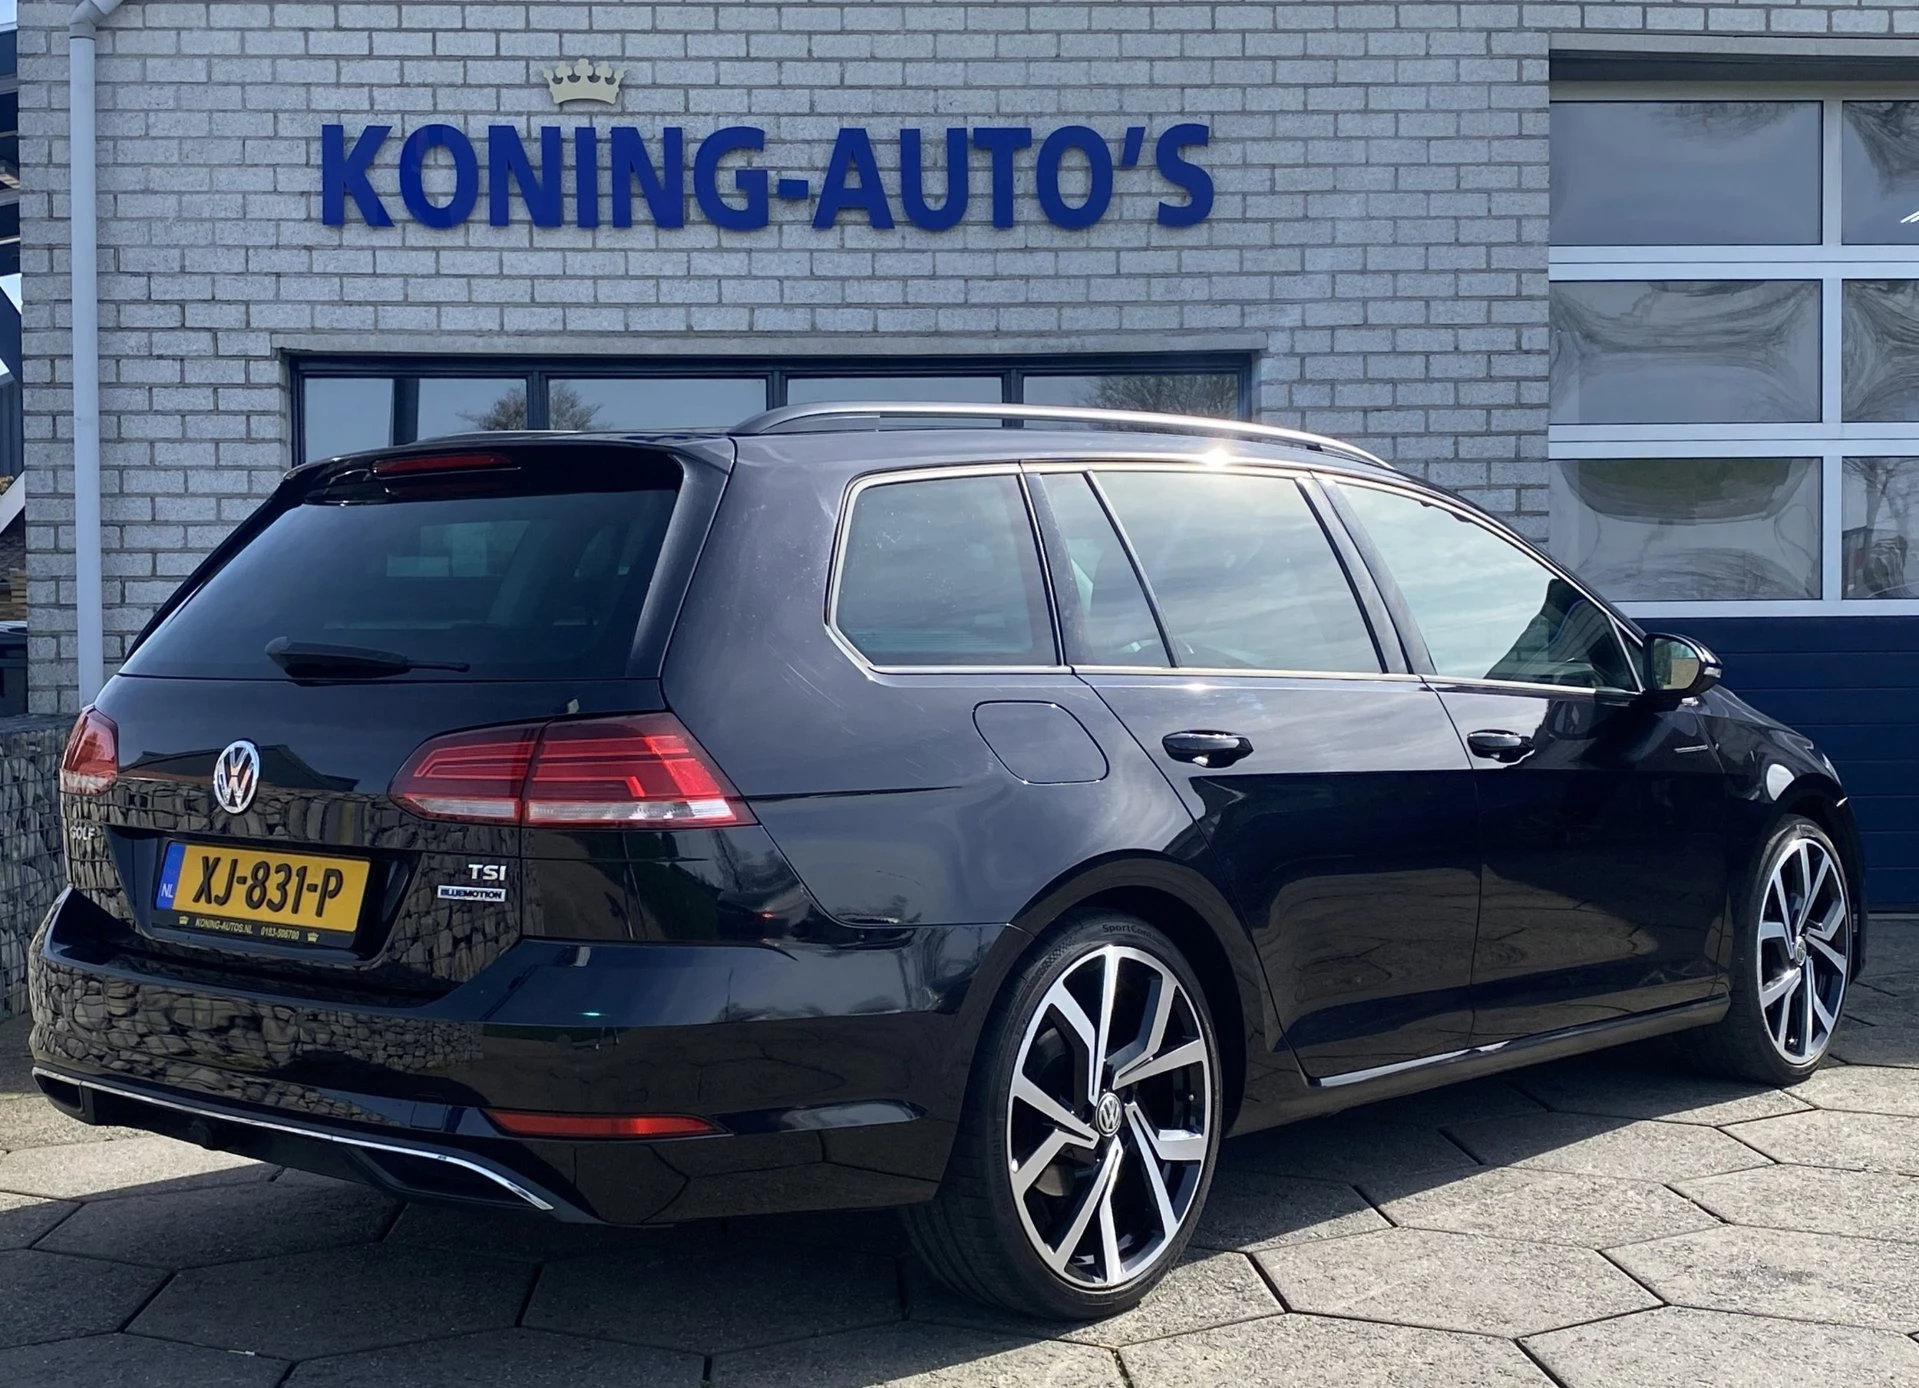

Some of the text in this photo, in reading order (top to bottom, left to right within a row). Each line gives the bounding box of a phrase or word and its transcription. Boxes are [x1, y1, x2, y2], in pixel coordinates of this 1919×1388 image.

[321, 123, 1215, 231] KONING-AUTO'S
[70, 825, 96, 840] GOLF
[468, 863, 507, 881] TSI
[161, 882, 174, 899] NL
[192, 855, 344, 918] XJ-831-P
[440, 888, 503, 899] BLUEMOTION
[195, 917, 253, 935] KONING-AUTOS.NL
